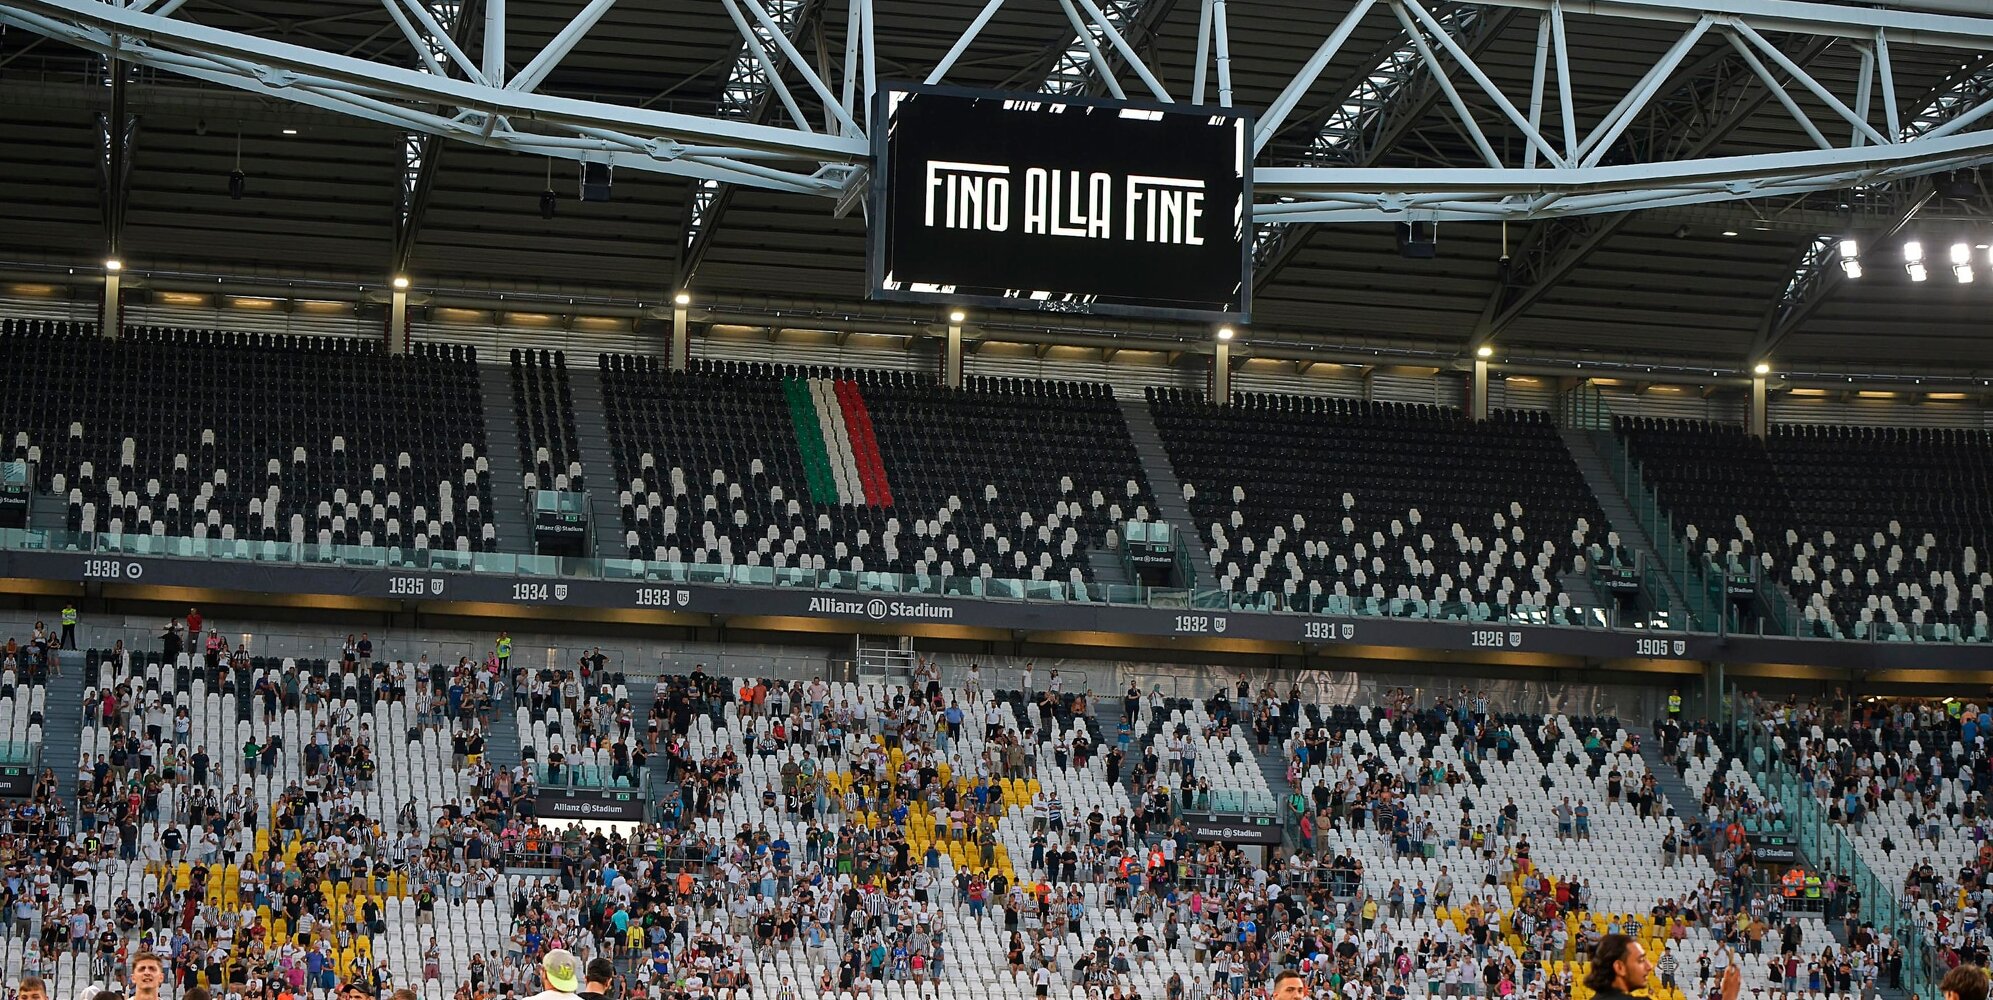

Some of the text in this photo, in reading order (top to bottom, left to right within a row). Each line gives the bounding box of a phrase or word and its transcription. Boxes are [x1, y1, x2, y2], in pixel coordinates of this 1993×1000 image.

[924, 160, 1206, 246] FINO ALLA FINE
[84, 560, 120, 578] 1938
[389, 577, 424, 595] 1935
[512, 583, 548, 600] 1934
[635, 588, 670, 606] 1933
[808, 597, 953, 618] Allianz Stadium
[1175, 616, 1208, 632] 1932
[1304, 622, 1337, 639] 1931
[1471, 631, 1504, 647] 1926
[1636, 639, 1668, 656] 1905
[554, 802, 622, 813] Allianz Stadium
[1197, 828, 1222, 836] Allianz
[1766, 848, 1794, 857] Stadium
